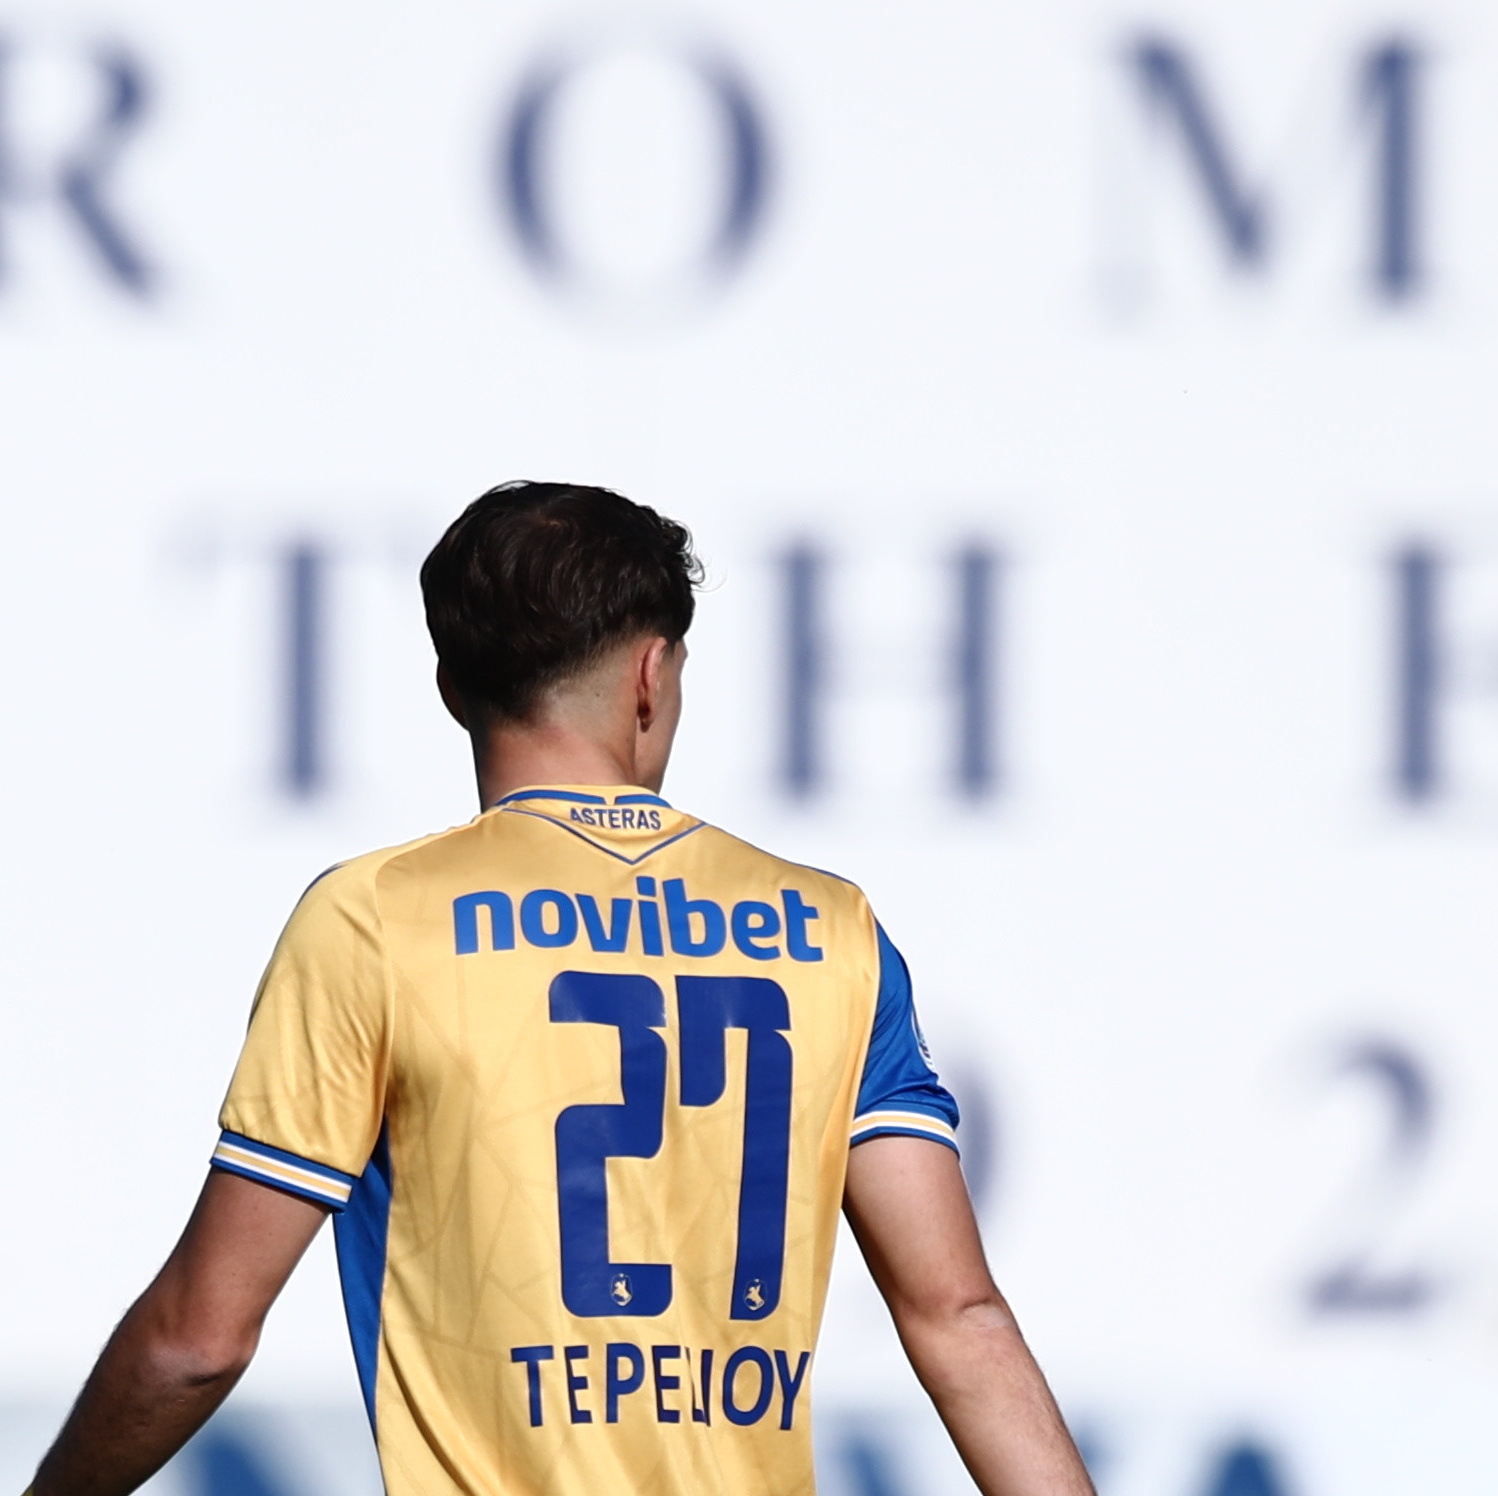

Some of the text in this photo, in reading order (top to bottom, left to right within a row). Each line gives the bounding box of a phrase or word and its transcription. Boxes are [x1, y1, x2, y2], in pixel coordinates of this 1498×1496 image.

[570, 807, 662, 831] ASTERAS
[453, 876, 824, 962] novibet
[548, 970, 794, 1321] 27
